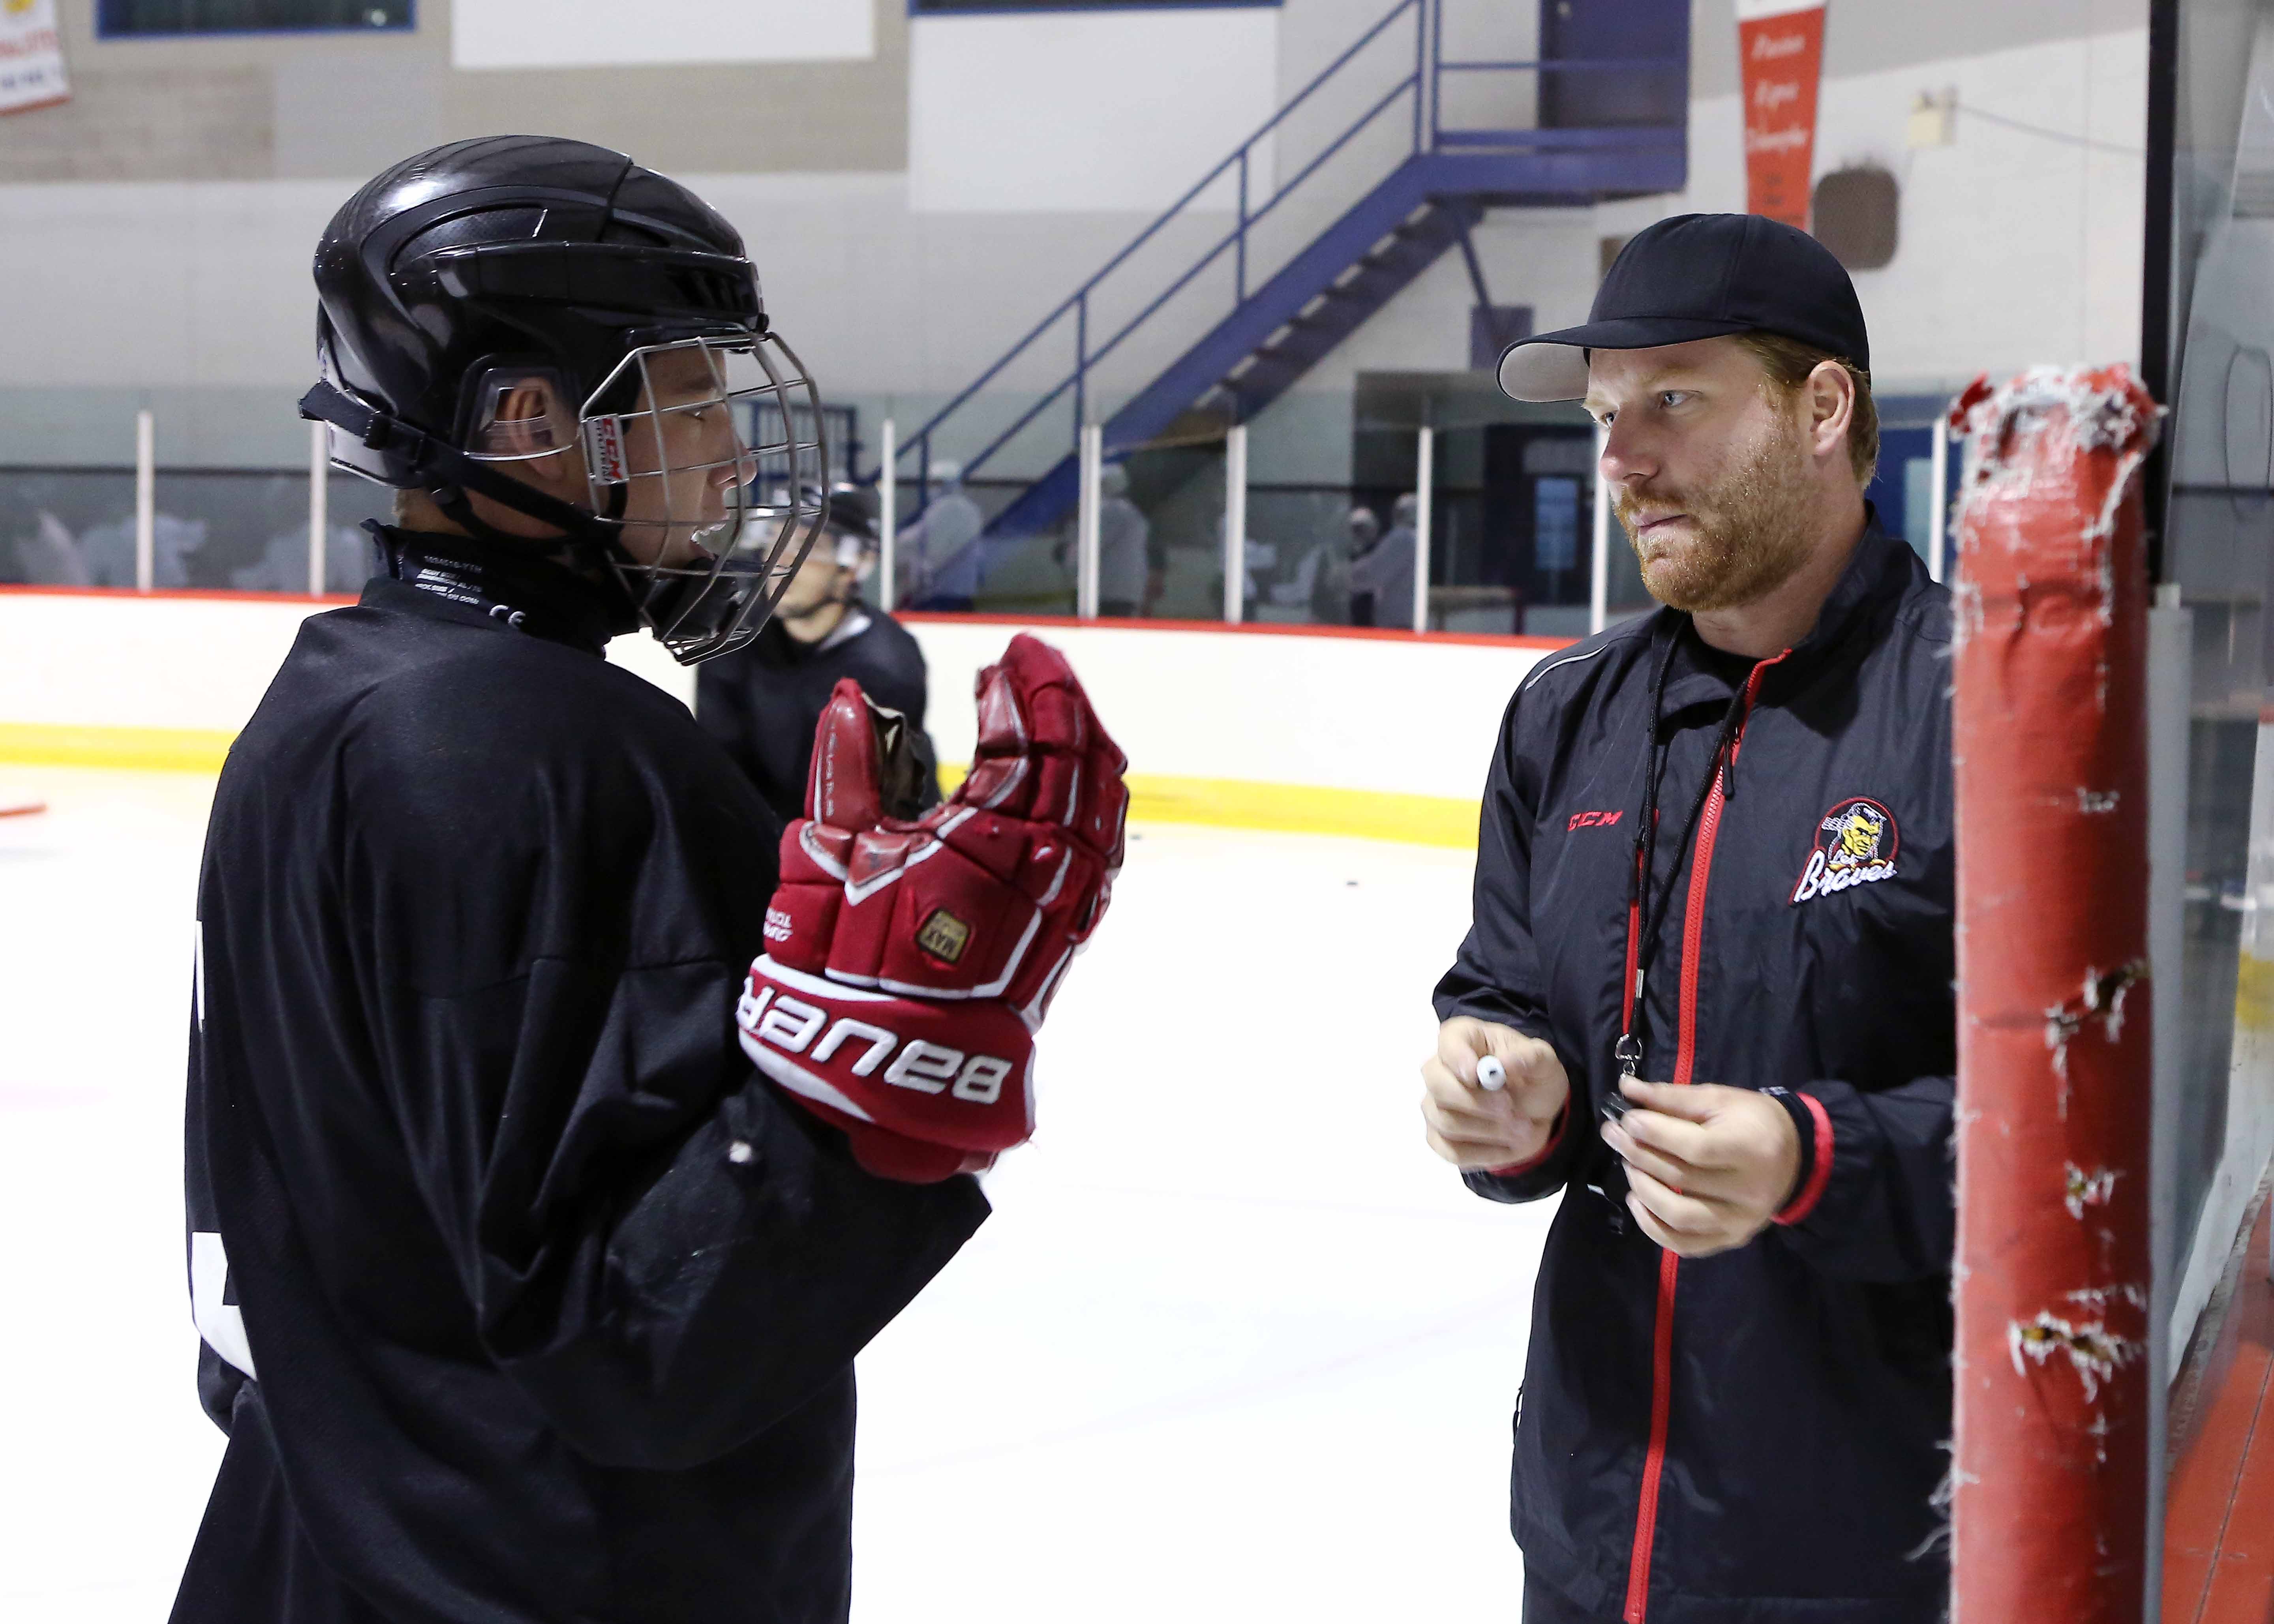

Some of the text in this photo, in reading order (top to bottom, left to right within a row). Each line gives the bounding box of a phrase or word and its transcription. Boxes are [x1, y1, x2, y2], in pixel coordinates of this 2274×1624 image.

[602, 418, 623, 479] CCM
[1567, 810, 1623, 831] CCM
[1794, 850, 1898, 902] Braves
